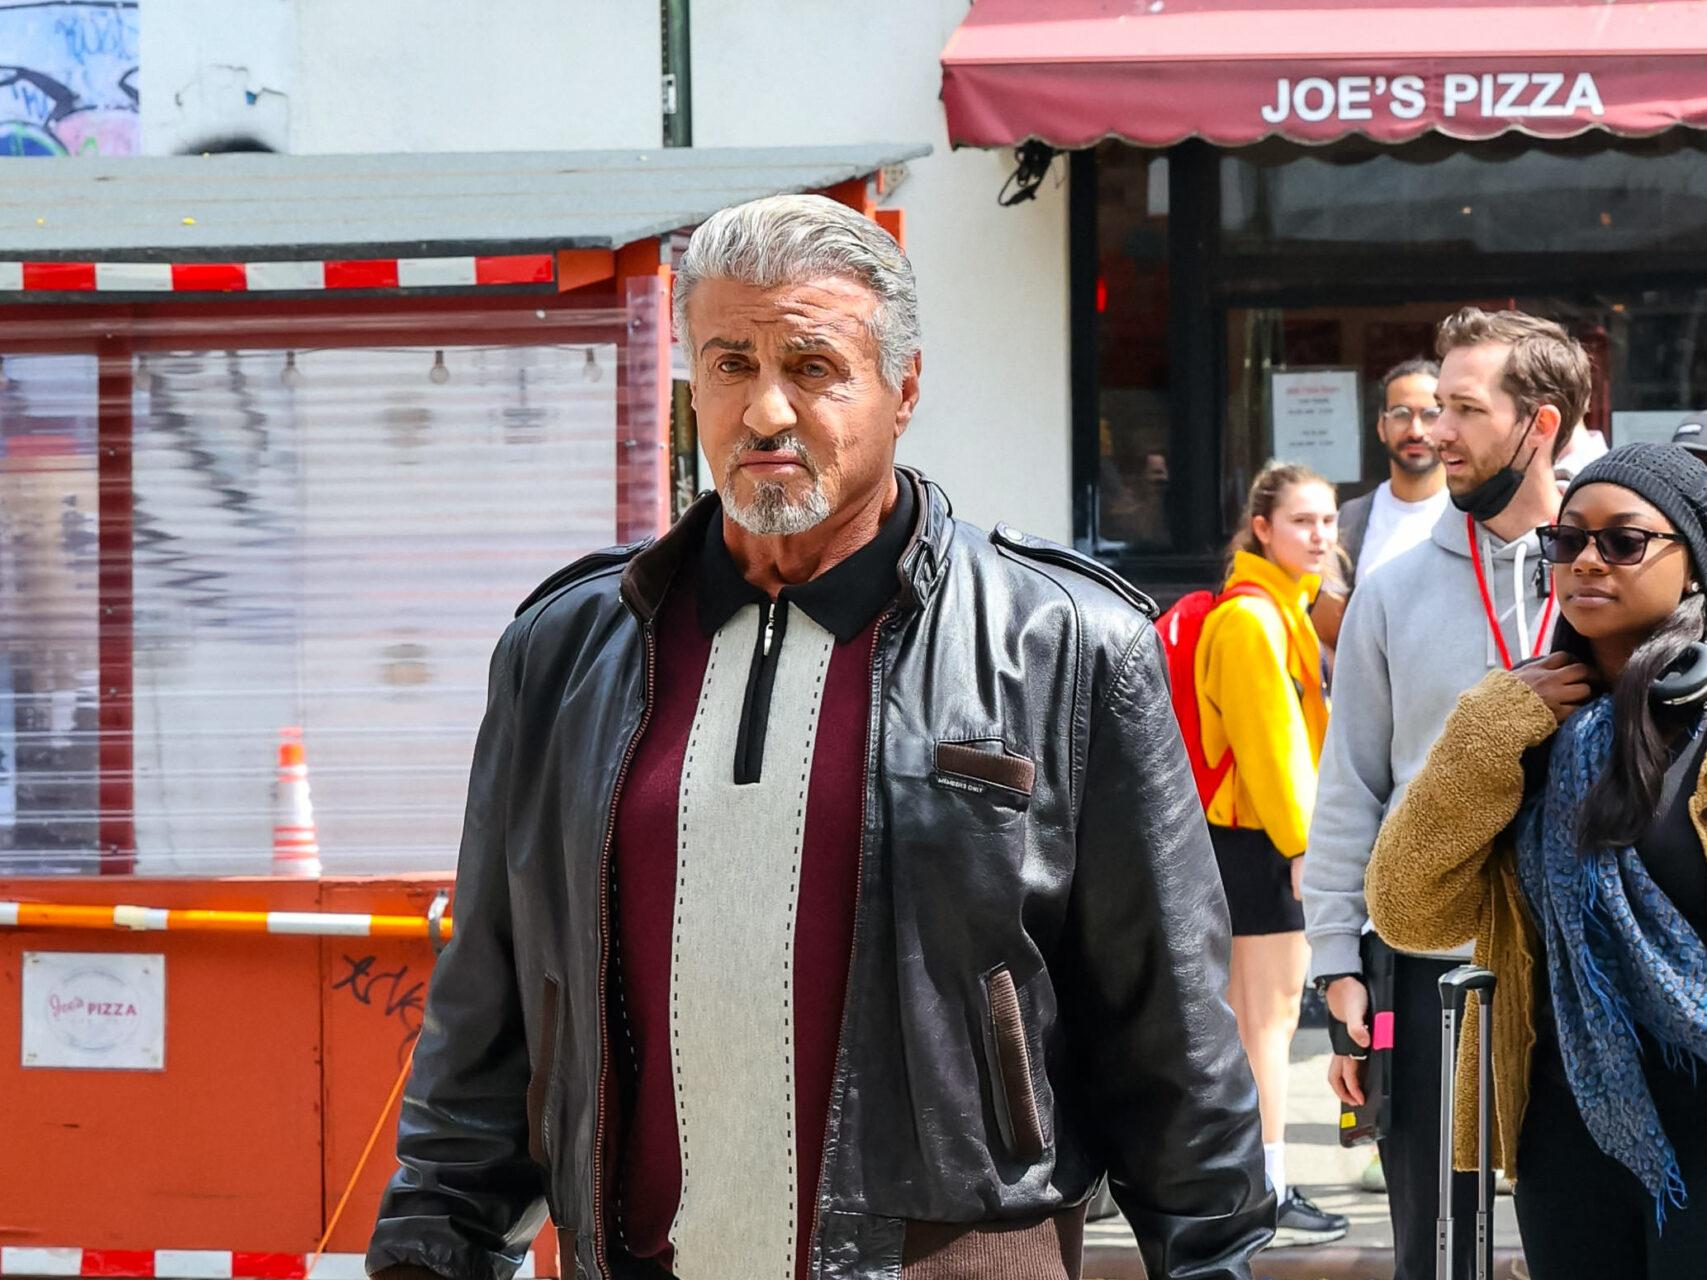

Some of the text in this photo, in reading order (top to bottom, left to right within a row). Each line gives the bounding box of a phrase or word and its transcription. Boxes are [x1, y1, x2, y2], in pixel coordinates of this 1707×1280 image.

[1261, 72, 1605, 123] JOE'S PIZZA
[937, 777, 983, 793] MEMBERS ONLY
[87, 1002, 138, 1016] PIZZA
